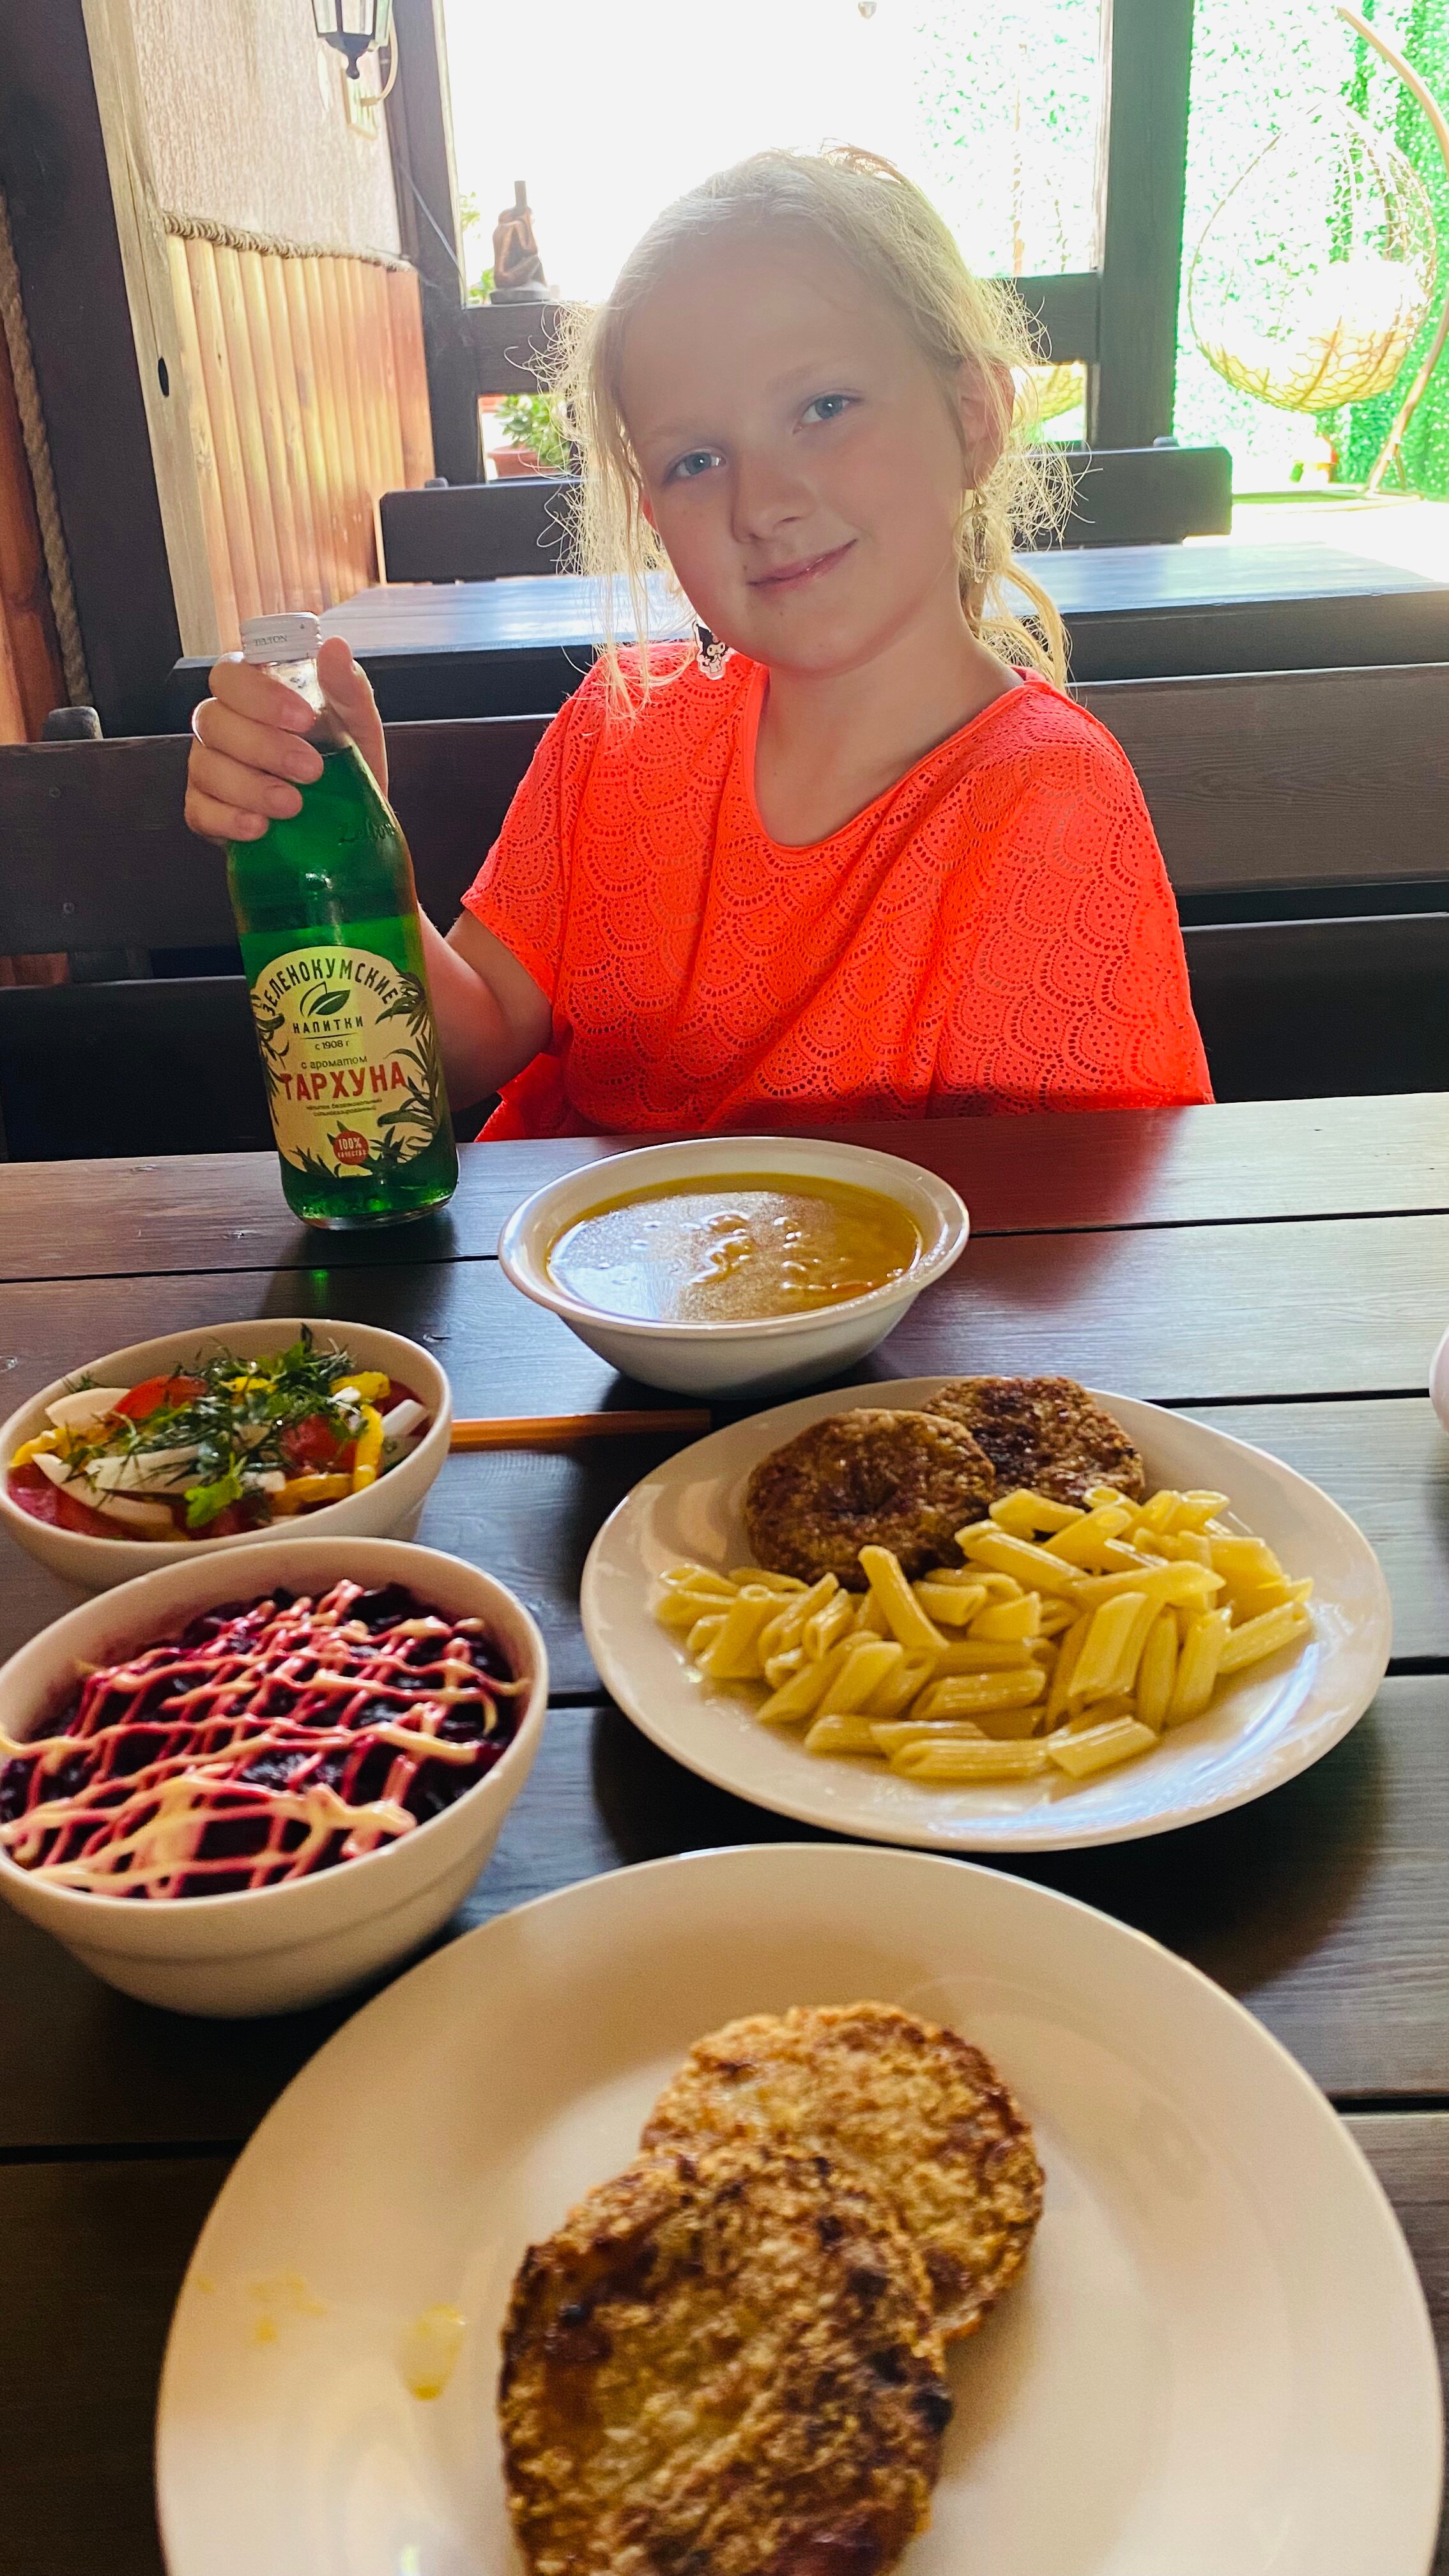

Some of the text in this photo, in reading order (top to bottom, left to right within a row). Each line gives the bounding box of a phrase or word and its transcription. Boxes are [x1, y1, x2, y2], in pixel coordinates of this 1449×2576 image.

[263, 958, 399, 1016] ЗЕЛЕНОКУМСКИЕ
[293, 1016, 364, 1034] НАПИТКИ
[322, 1040, 344, 1050] 1908
[301, 1055, 367, 1070] с ароматом
[280, 1061, 407, 1101] ТАРХУНА
[339, 1137, 362, 1151] 100%
